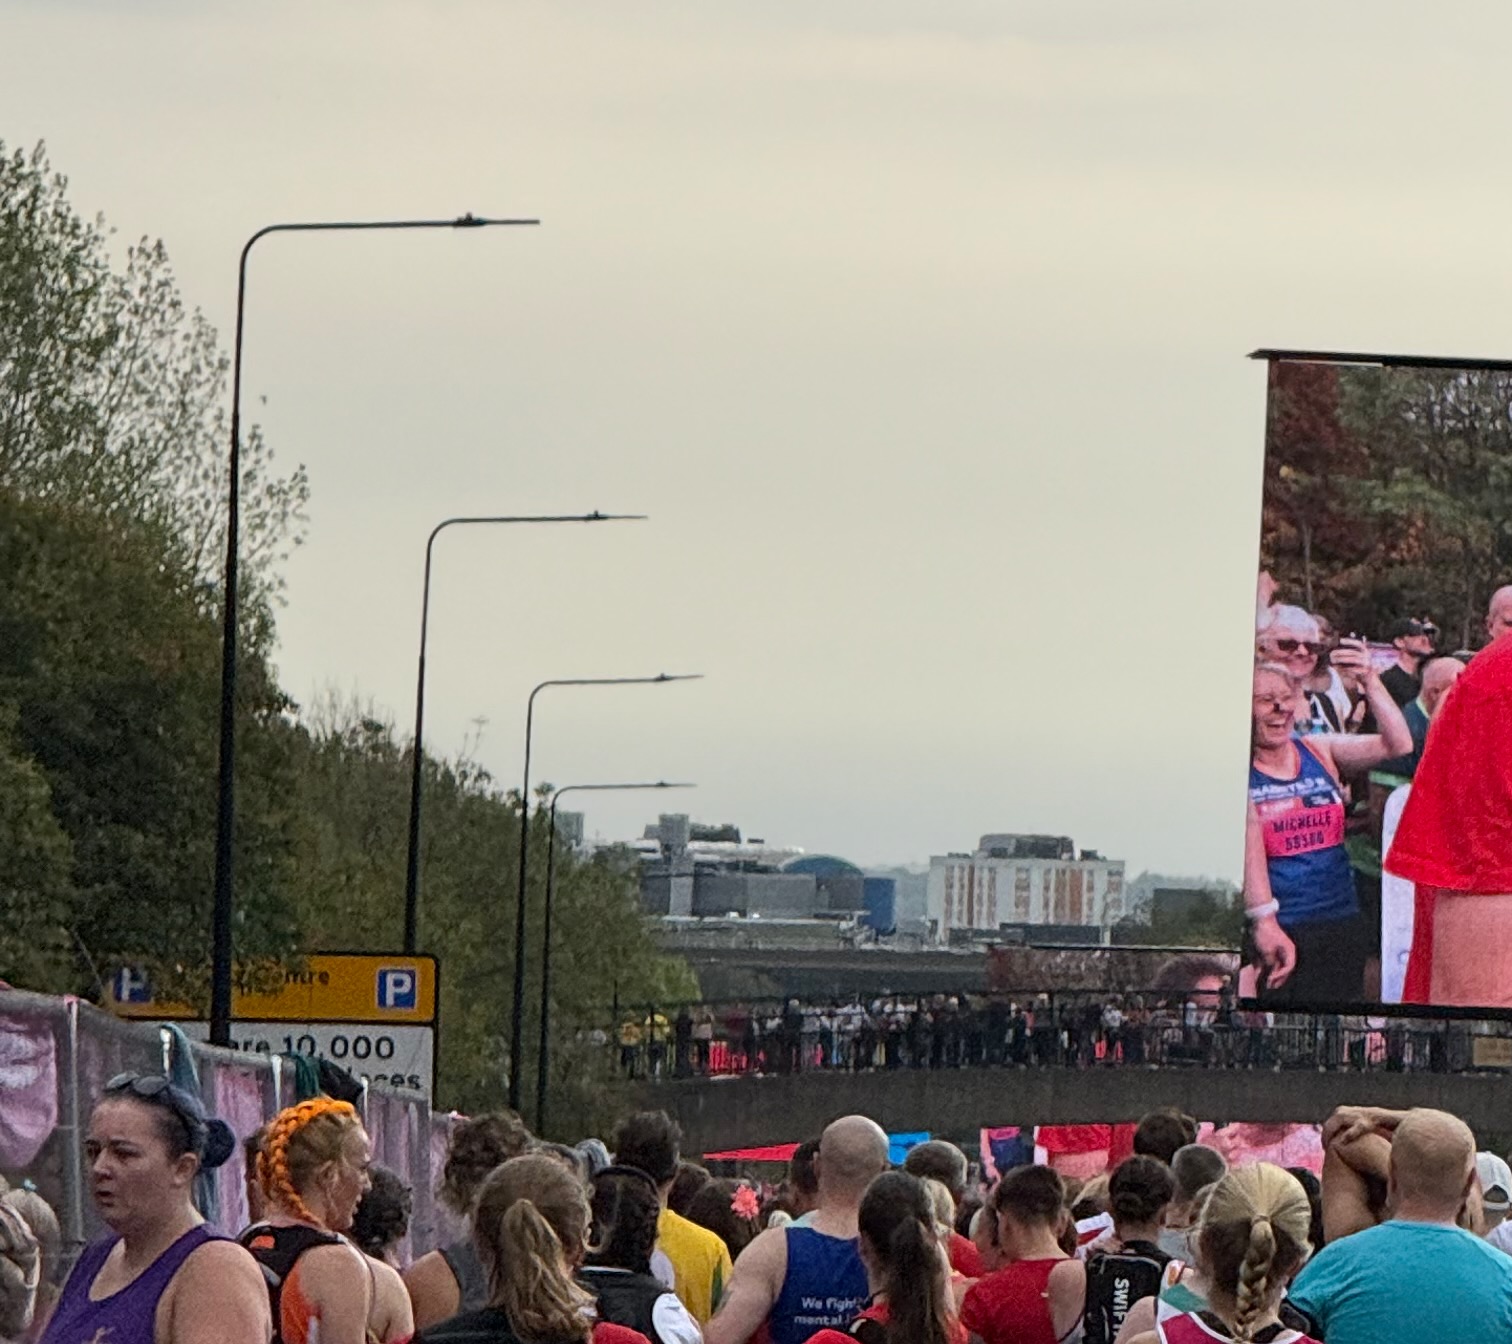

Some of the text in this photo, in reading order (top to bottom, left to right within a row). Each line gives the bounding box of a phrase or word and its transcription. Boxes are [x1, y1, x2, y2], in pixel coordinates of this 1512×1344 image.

[1273, 811, 1332, 833] MICHELLE
[385, 972, 412, 1006] P
[801, 1297, 823, 1310] We
